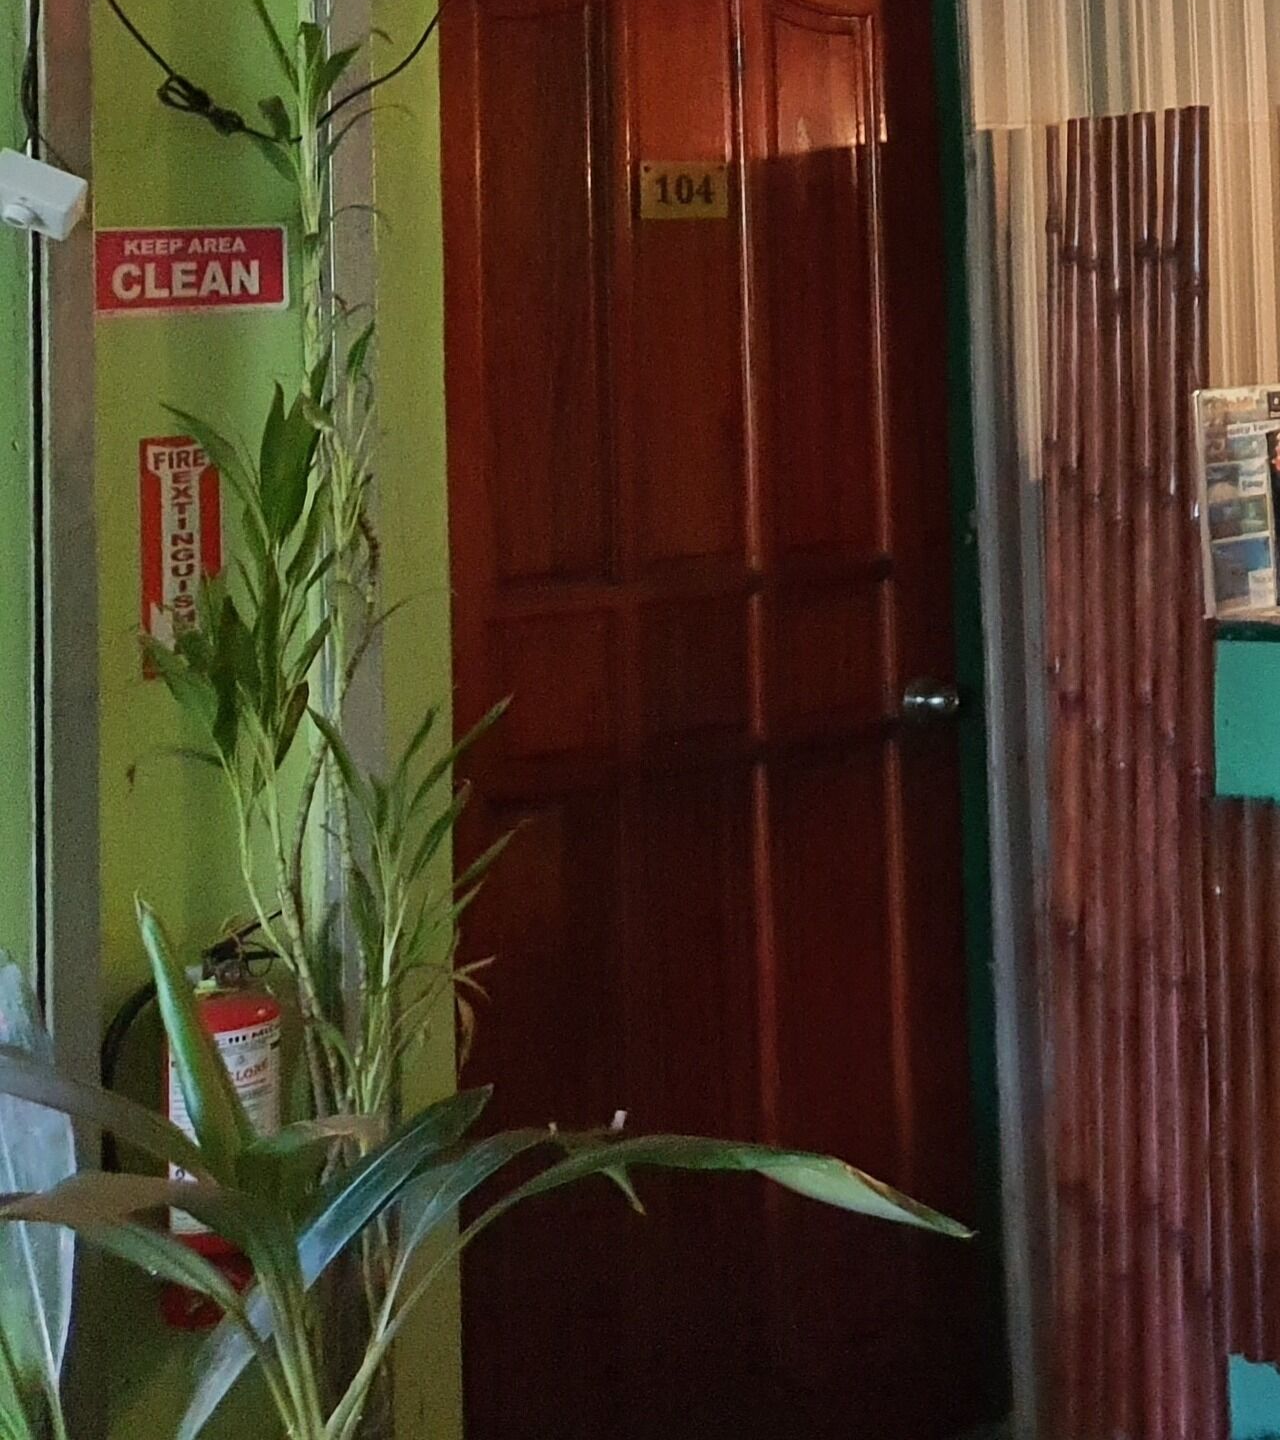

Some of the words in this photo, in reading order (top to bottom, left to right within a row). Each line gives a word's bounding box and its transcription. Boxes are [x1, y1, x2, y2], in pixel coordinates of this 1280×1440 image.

[655, 173, 716, 205] 104
[124, 238, 183, 256] KEEP
[187, 236, 247, 254] AREA
[112, 259, 260, 301] CLEAN
[152, 449, 206, 471] FIRE
[170, 471, 196, 624] EXTINGUISH
